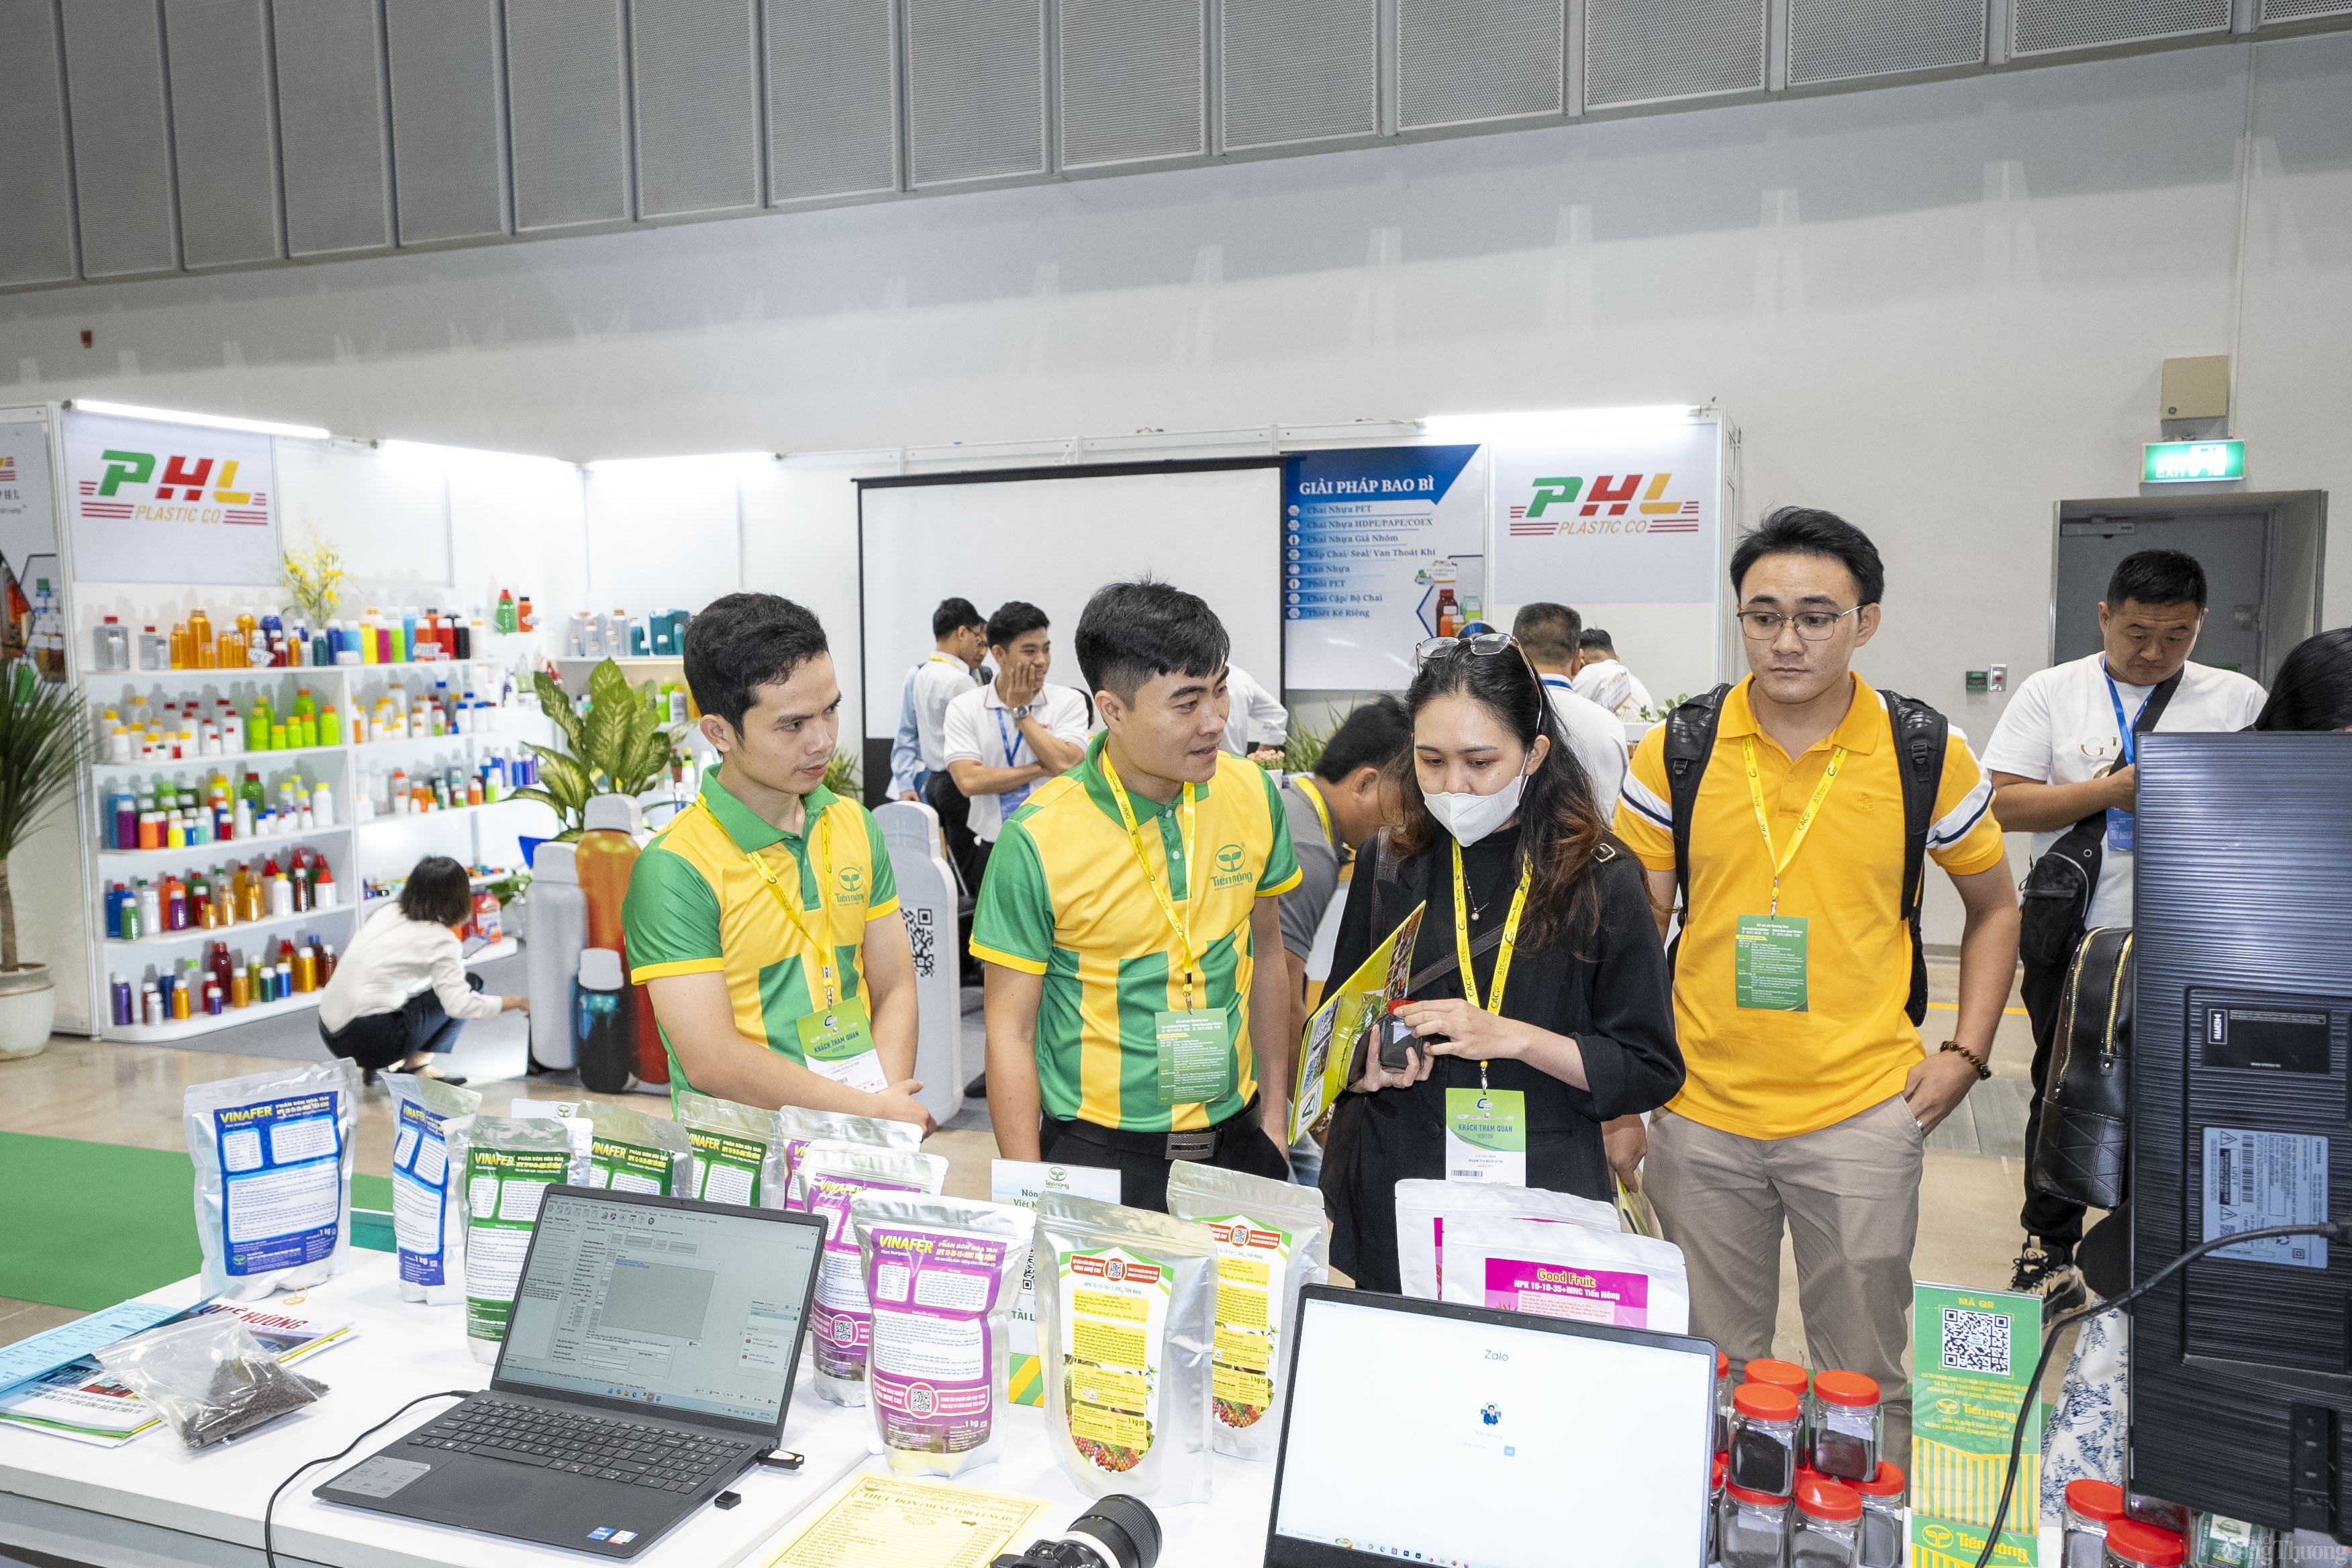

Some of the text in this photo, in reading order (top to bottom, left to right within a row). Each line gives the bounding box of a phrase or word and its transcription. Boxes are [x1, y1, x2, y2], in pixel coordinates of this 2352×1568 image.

[97, 449, 252, 504] PHL
[2156, 467, 2186, 478] EXIT
[1300, 475, 1434, 495] GIẢI PHÁP BAO BÌ
[1526, 473, 1682, 518] PHL
[135, 505, 222, 524] PLASTIC CO
[1307, 505, 1372, 515] Chai Nhựa PET
[1307, 521, 1326, 529] Chai
[1329, 520, 1353, 529] Nhựa
[1558, 520, 1647, 535] PLASTIC CO
[1307, 535, 1326, 544] Chai
[1329, 535, 1353, 544] Nhựa
[1308, 565, 1351, 574] Can Nhựa
[1329, 579, 1346, 587] PET
[1363, 593, 1383, 601] Chai
[831, 1036, 846, 1047] THAM
[846, 1030, 860, 1040] QUAN
[219, 1106, 273, 1124] VINAFER
[1459, 1122, 1477, 1132] KHÁCH
[475, 1152, 515, 1167] VINAFER
[324, 1228, 331, 1236] kg
[880, 1234, 934, 1254] VINAFER
[986, 1245, 998, 1253] TAN
[420, 1256, 428, 1266] kg
[1537, 1269, 1596, 1288] Good Fruit
[1514, 1279, 1620, 1301] NPK 15-10-35+MNC Tiến Nông
[1959, 1297, 1995, 1309] MÃ QR
[1012, 1308, 1028, 1322] TÀI
[1484, 1349, 1509, 1363] Zalo
[970, 1419, 979, 1428] kg
